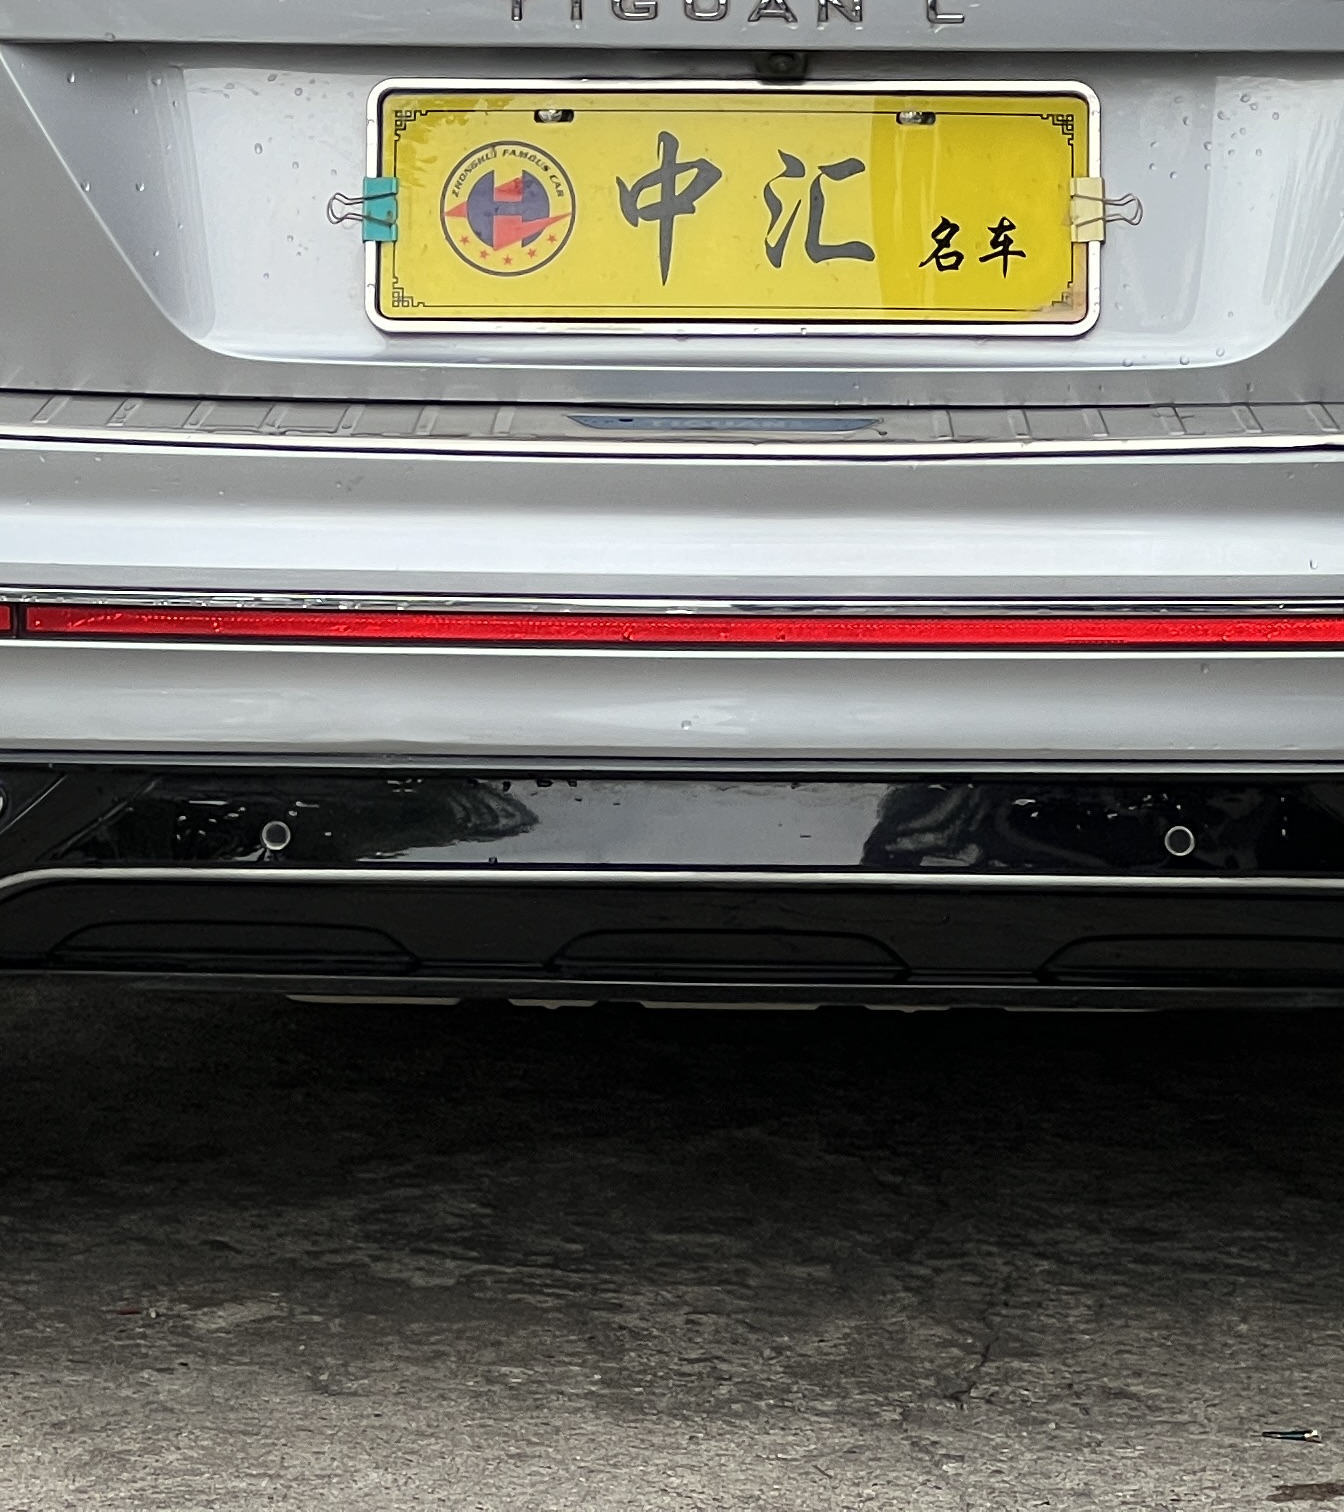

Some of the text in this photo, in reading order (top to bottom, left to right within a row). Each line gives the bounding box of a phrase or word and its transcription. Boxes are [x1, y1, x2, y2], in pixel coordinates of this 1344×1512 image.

[502, 149, 551, 172] FAMOUS
[549, 174, 565, 198] CAR
[616, 131, 1028, 287] 中汇 名车
